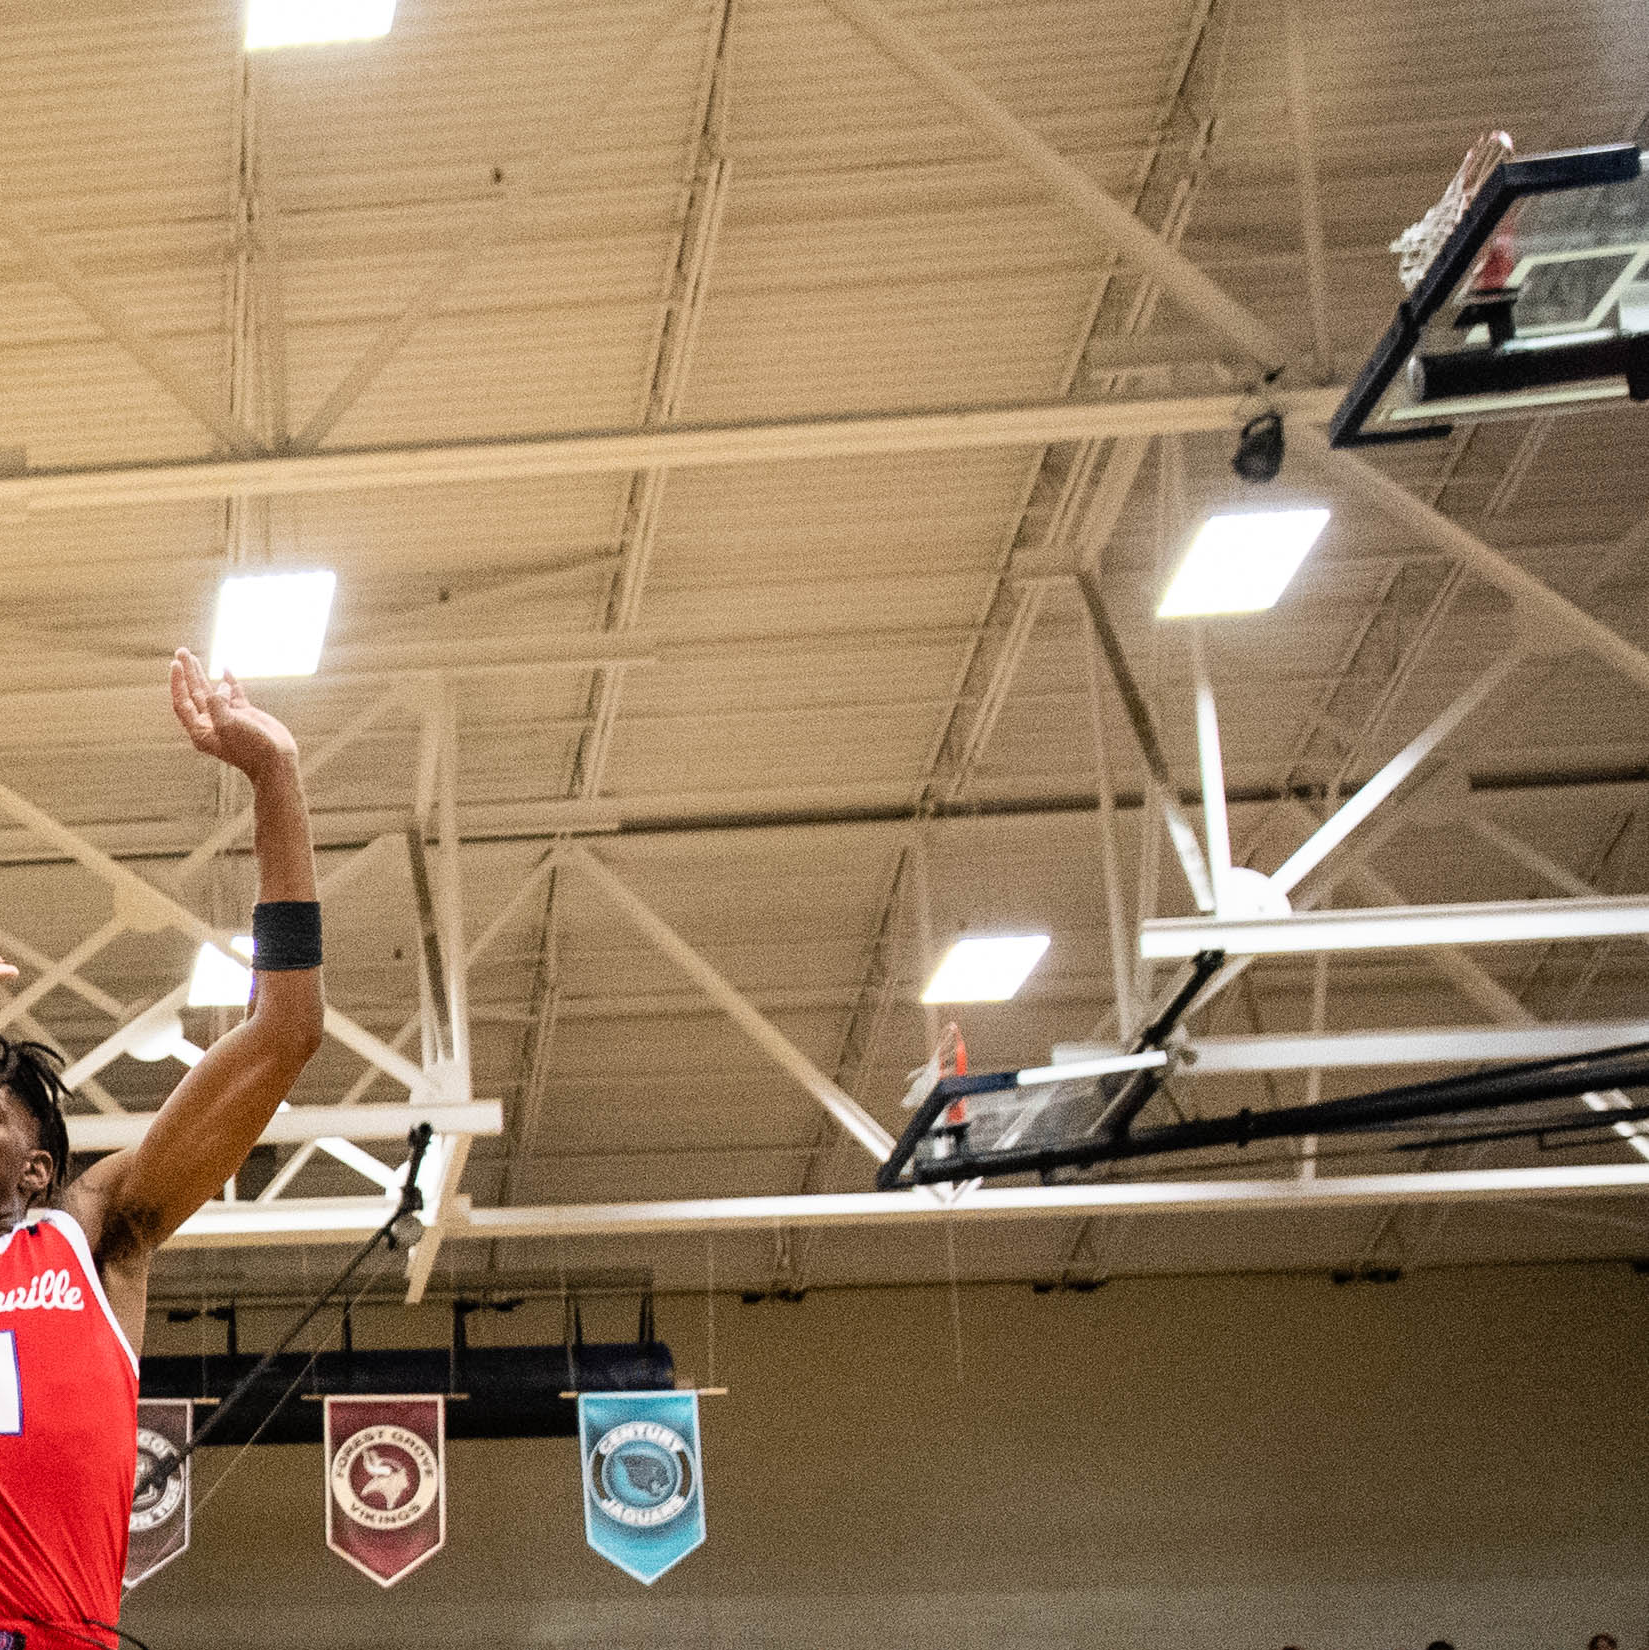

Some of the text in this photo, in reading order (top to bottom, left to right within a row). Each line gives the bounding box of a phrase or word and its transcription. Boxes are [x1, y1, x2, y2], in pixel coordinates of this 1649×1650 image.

[335, 1427, 440, 1478] FOREST GROVE
[348, 1500, 423, 1526] VIKINGS
